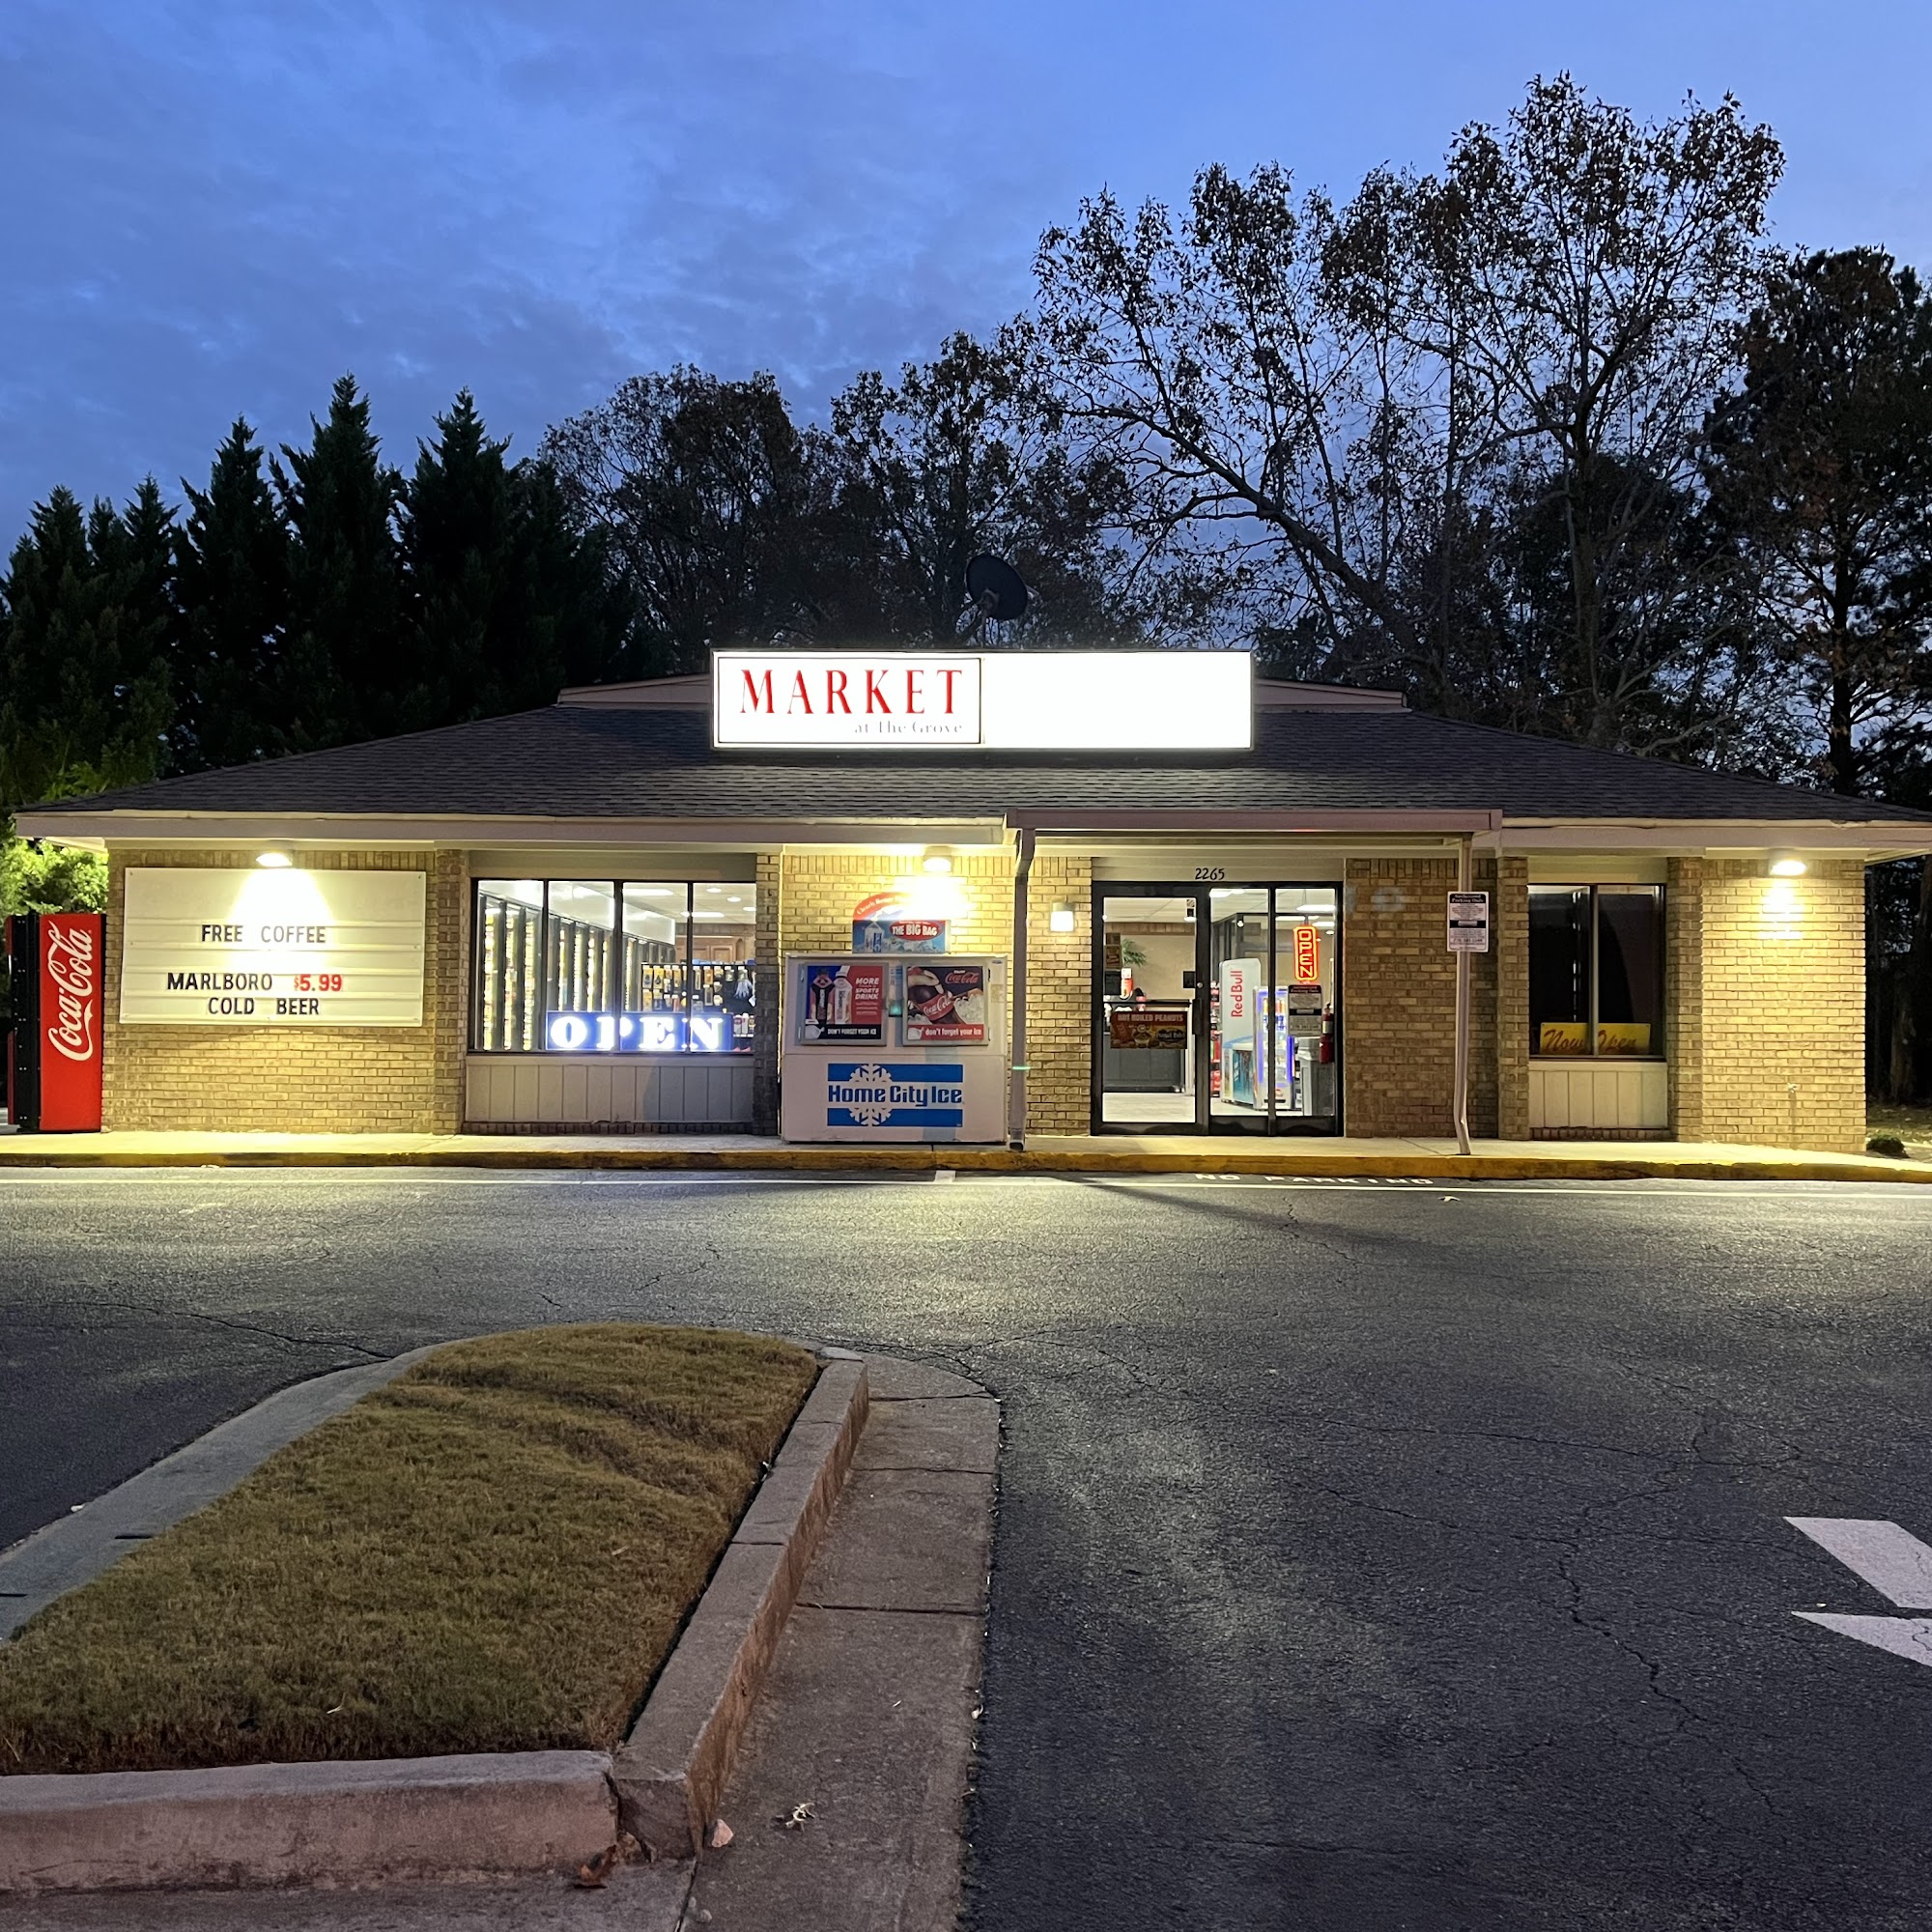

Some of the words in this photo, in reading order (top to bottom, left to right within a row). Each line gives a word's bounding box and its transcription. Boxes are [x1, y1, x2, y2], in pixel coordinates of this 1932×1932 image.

[740, 669, 962, 714] MARKET
[855, 722, 868, 733] at
[912, 721, 962, 733] Grove
[1195, 867, 1225, 880] 2265
[201, 924, 243, 943] FREE
[261, 924, 327, 943] COFFEE
[892, 925, 905, 935] THE
[905, 924, 922, 936] BIG
[922, 925, 938, 936] BAG
[1296, 929, 1315, 979] OPEN
[48, 920, 93, 1061] Coca-Cola
[167, 973, 272, 991] MARLBORO
[294, 973, 343, 992] $5.99
[1230, 970, 1243, 993] Bull
[208, 997, 255, 1015] COLD
[276, 997, 320, 1015] BEER
[1230, 995, 1243, 1018] Red
[1154, 1013, 1183, 1022] PEANUTS
[550, 1015, 724, 1050] OPEN
[942, 1028, 959, 1037] forget
[1544, 1029, 1584, 1051] Now
[828, 1085, 886, 1103] Home
[890, 1085, 927, 1107] City
[932, 1085, 963, 1103] Ice
[1264, 1175, 1435, 1185] PARKING
